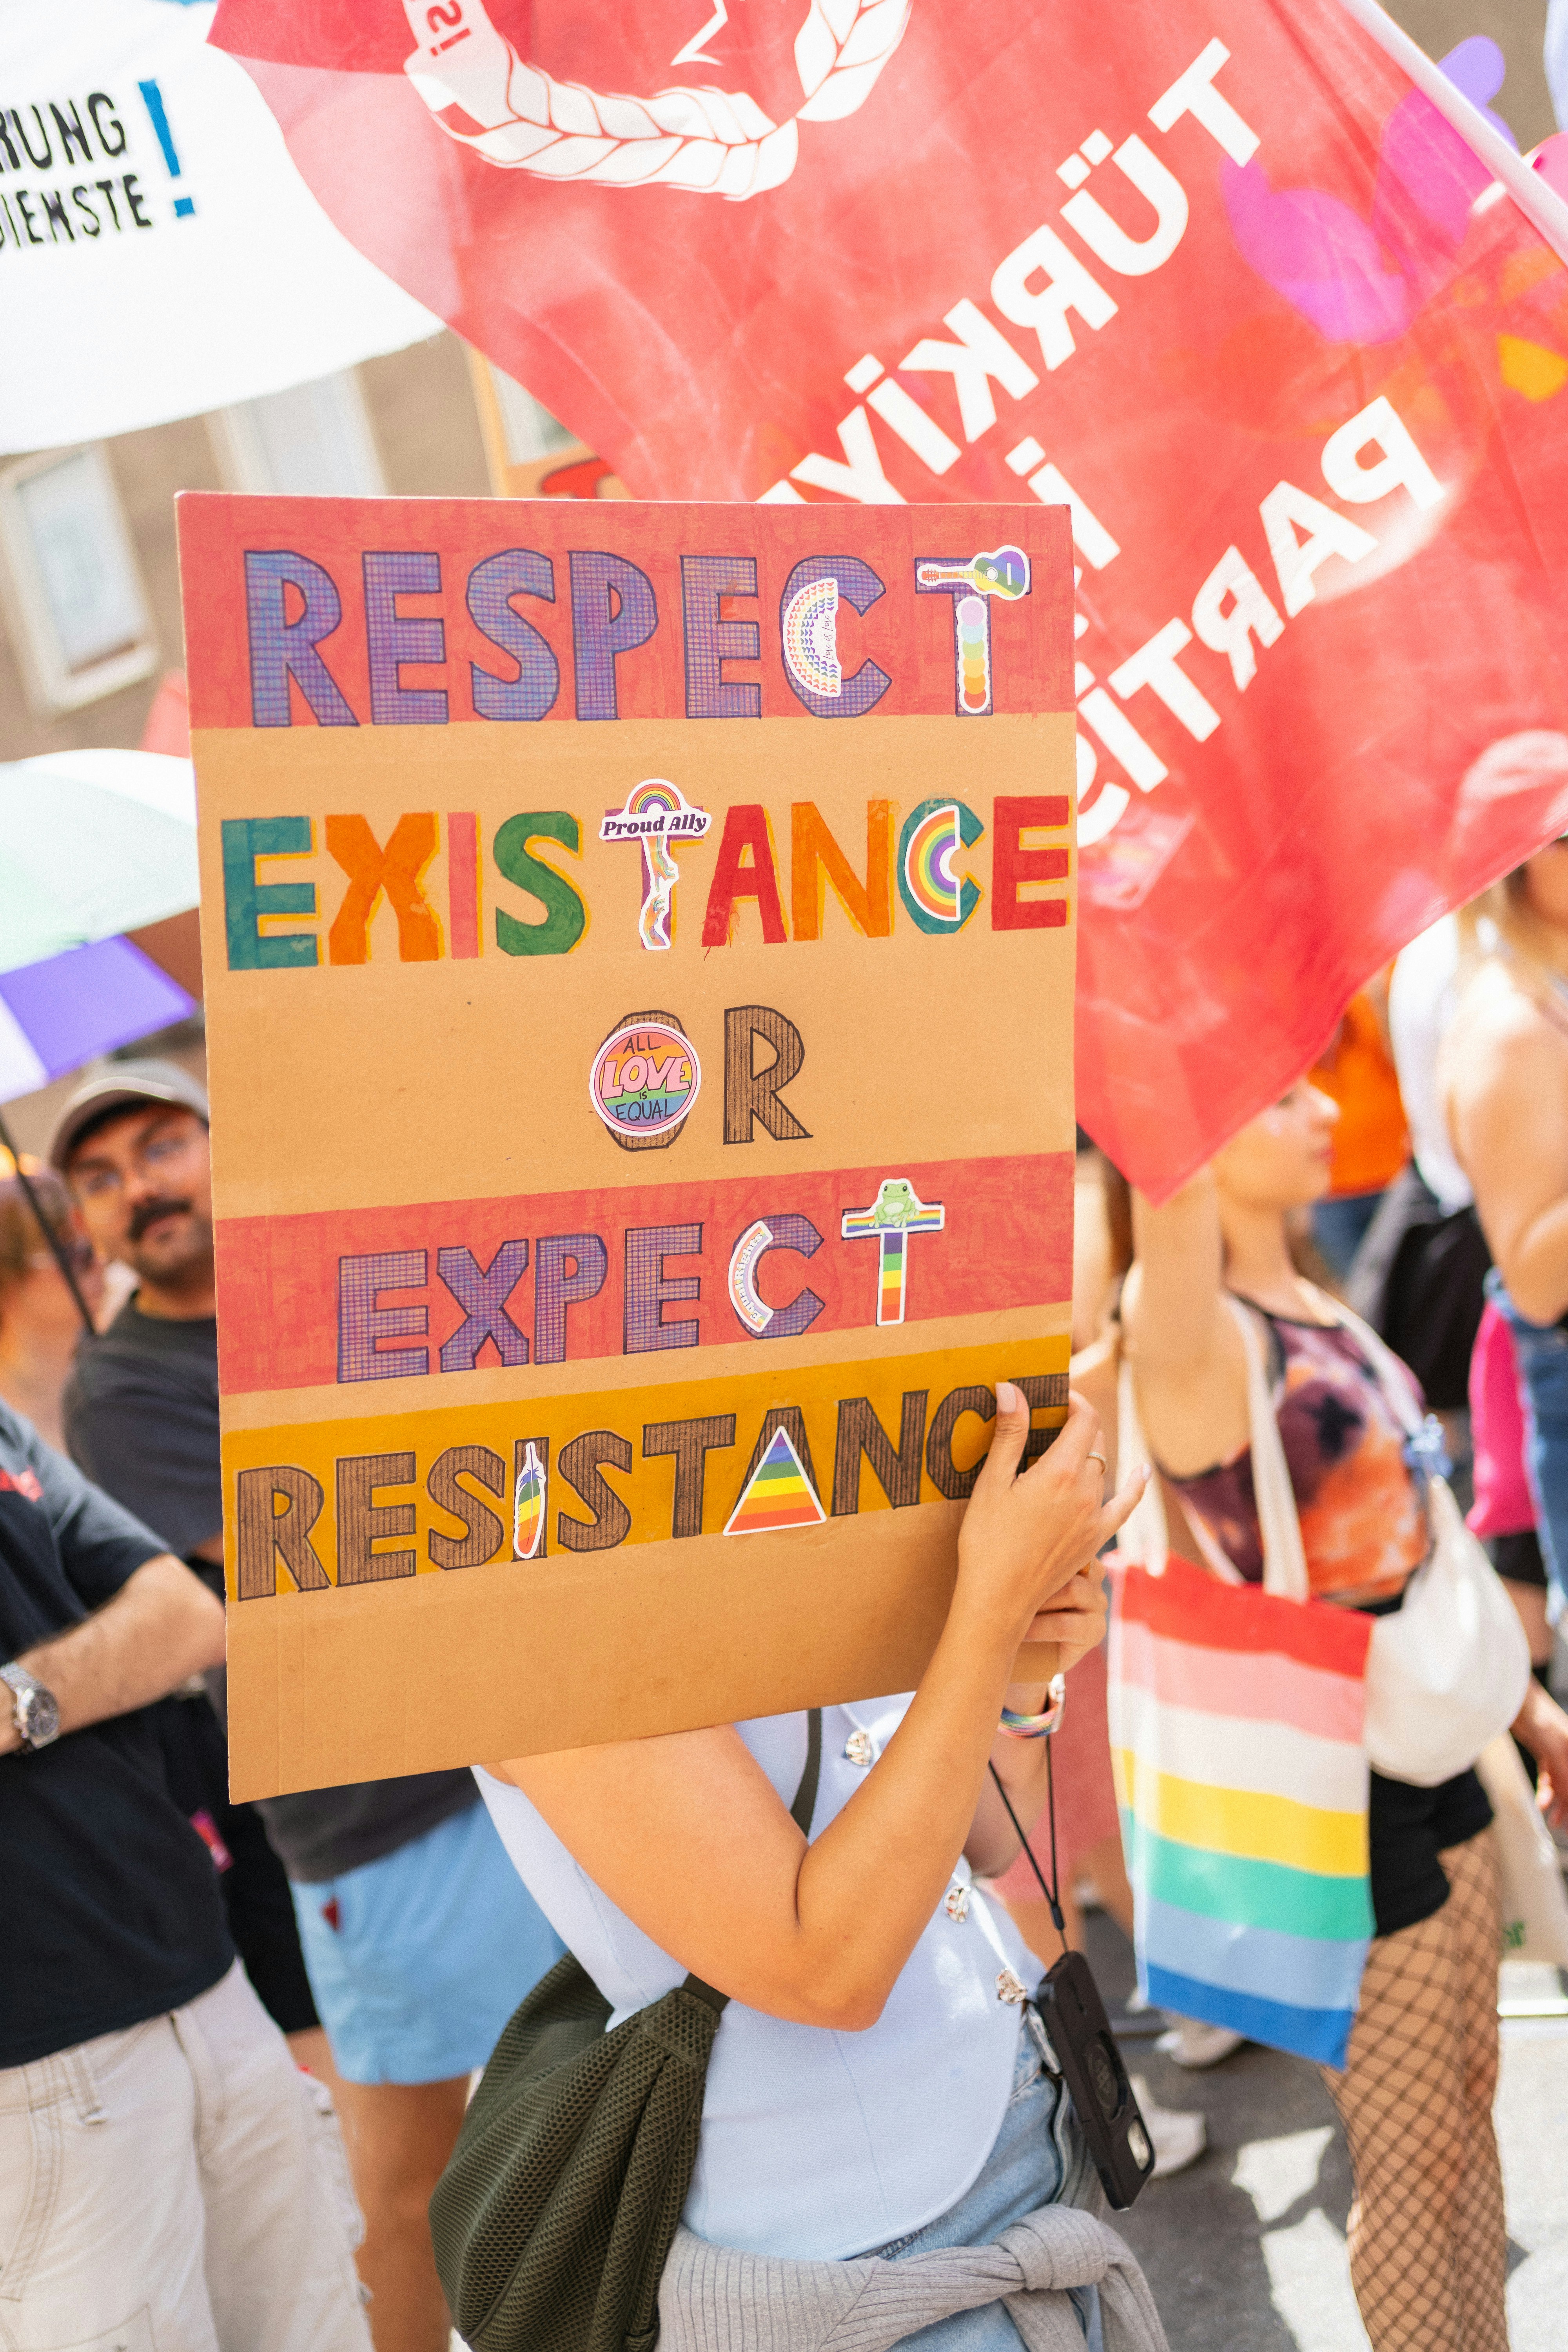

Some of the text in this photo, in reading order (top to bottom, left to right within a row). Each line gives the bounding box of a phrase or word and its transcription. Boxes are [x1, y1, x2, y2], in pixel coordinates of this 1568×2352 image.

[0, 174, 152, 251] IENSTE
[243, 547, 1033, 728] RESPECT
[603, 813, 707, 836] Proud Ally
[220, 795, 1070, 972] EXISTANCE
[623, 1034, 661, 1054] ALL
[589, 1004, 813, 1152] OR
[601, 1055, 691, 1100] LOVE
[639, 1091, 648, 1100] IS
[615, 1098, 674, 1122] EQUAL
[336, 1192, 946, 1384] EXPECT
[734, 1282, 762, 1323] Equal
